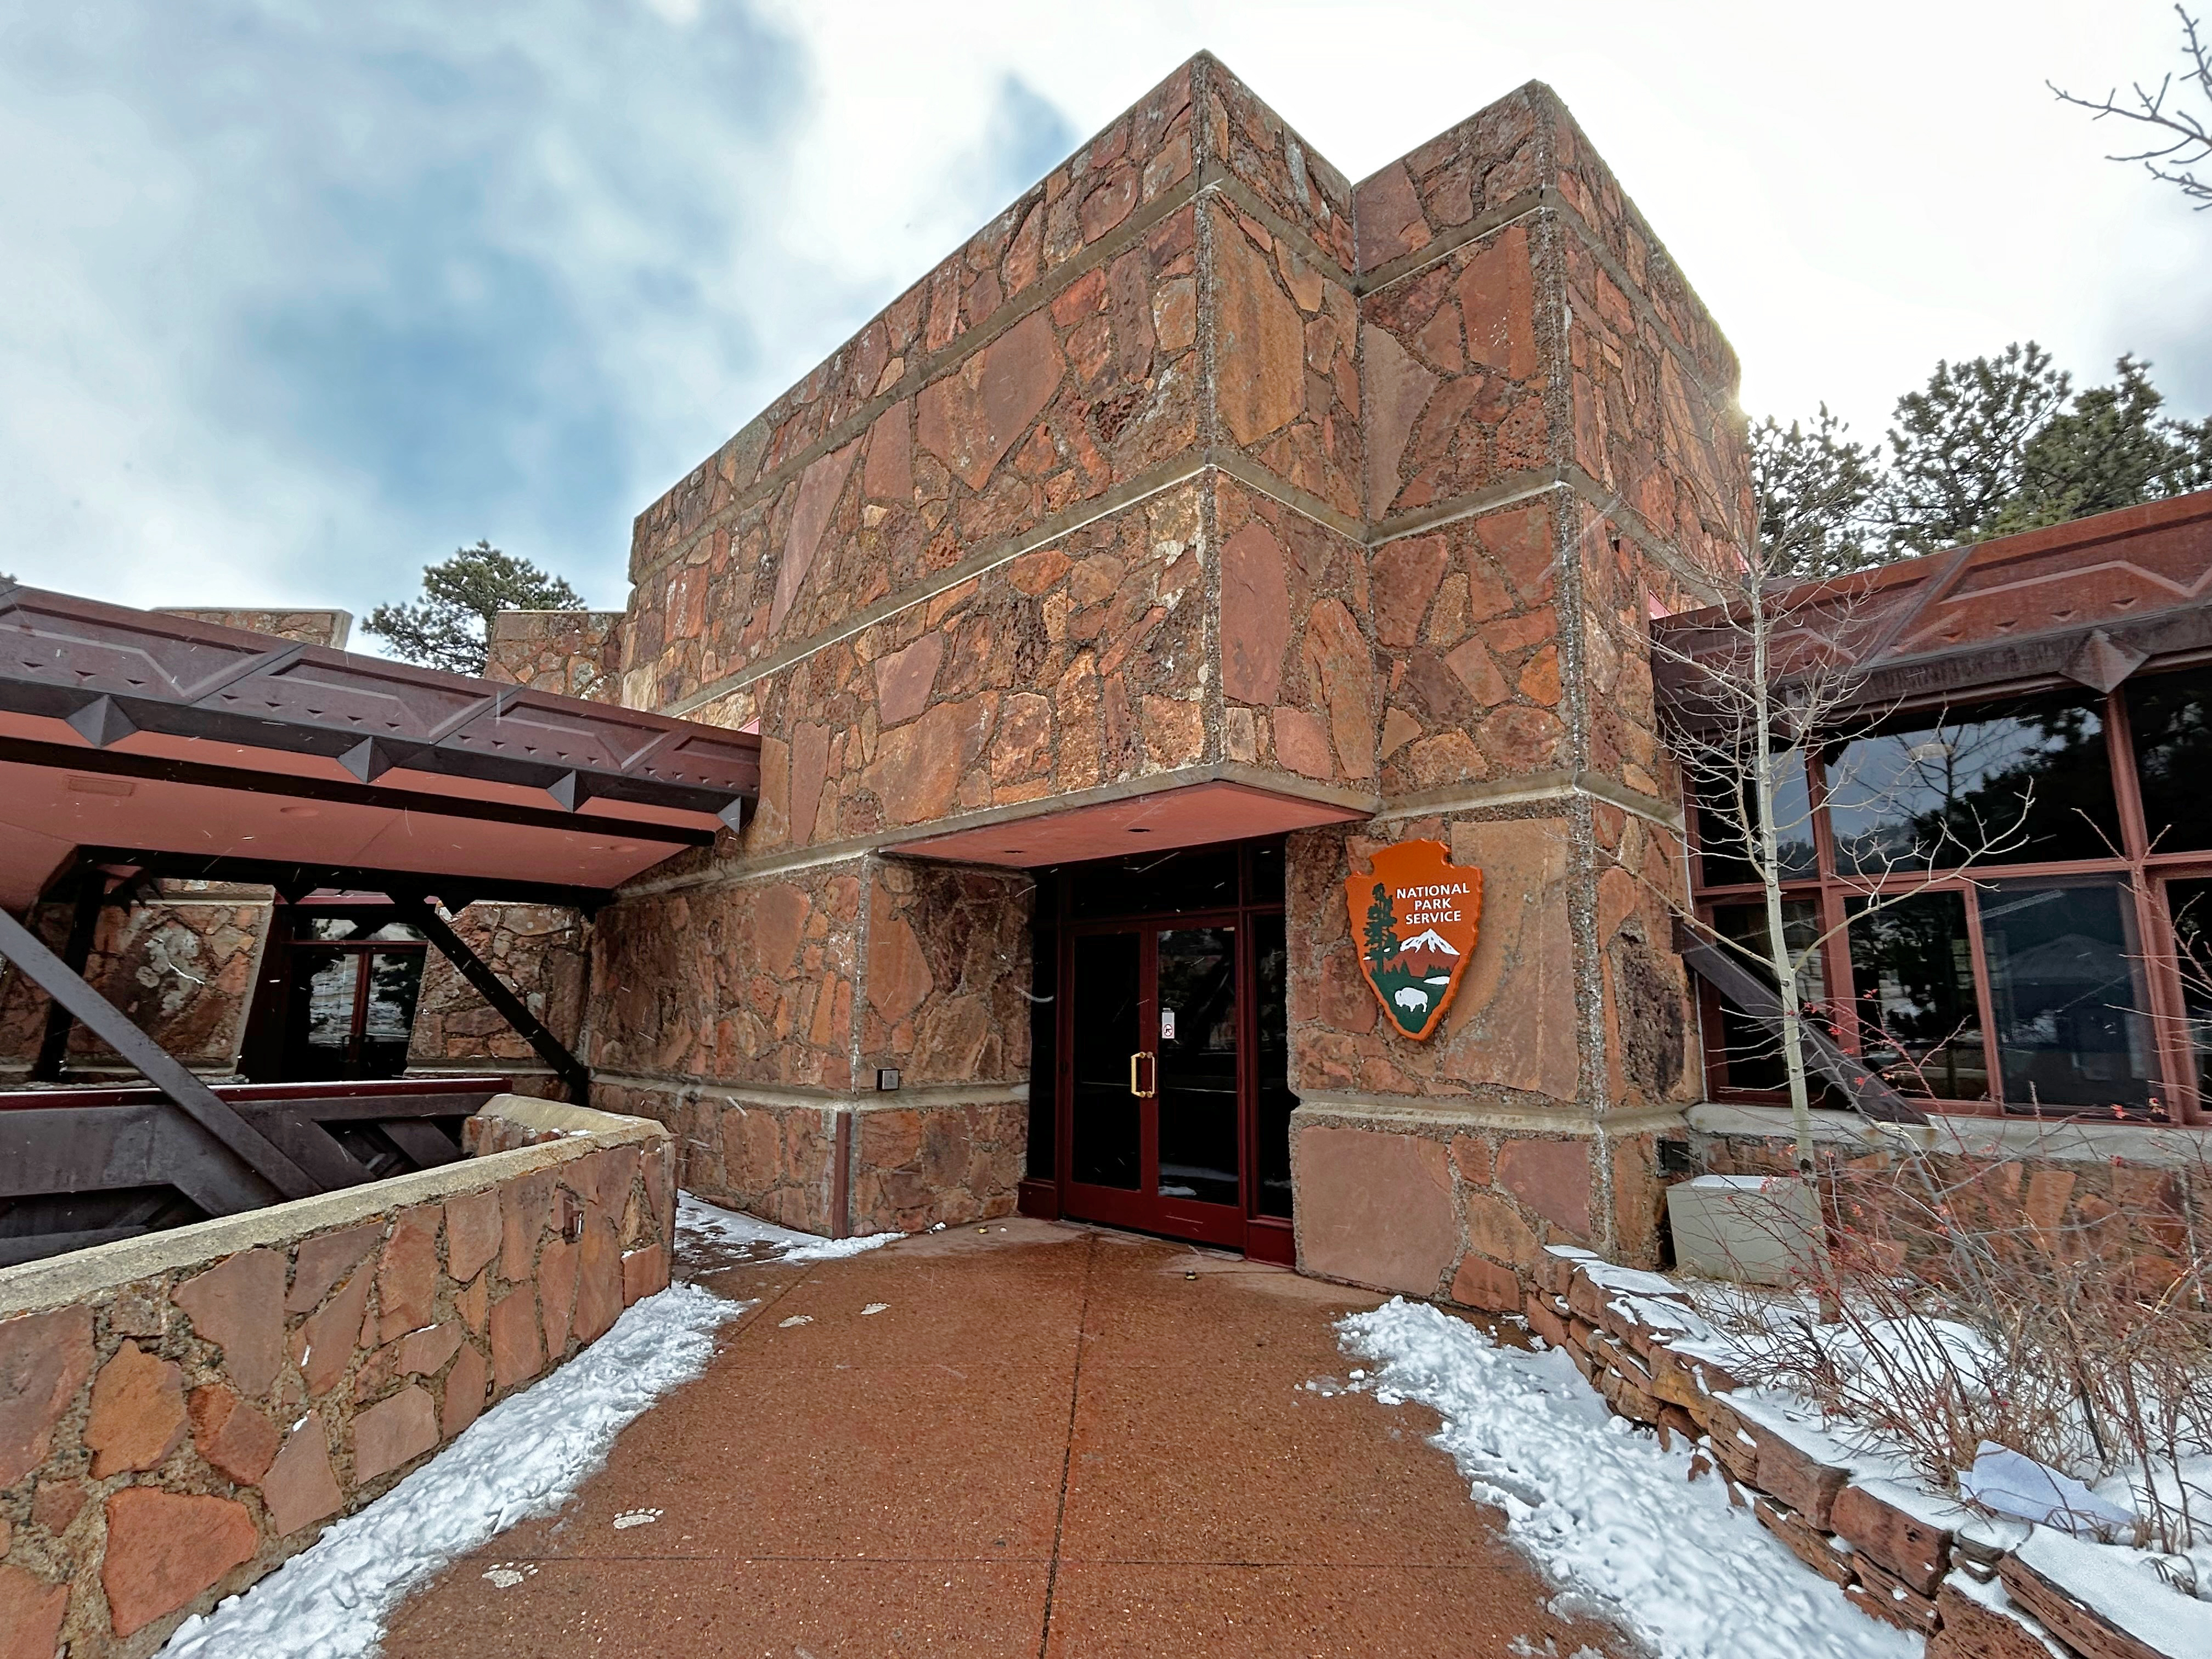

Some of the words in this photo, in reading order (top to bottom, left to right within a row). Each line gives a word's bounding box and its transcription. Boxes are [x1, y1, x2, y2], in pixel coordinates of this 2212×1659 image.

[1397, 883, 1470, 899] NATIONAL
[1414, 898, 1452, 911] PARK
[1406, 910, 1462, 924] SERVICE
